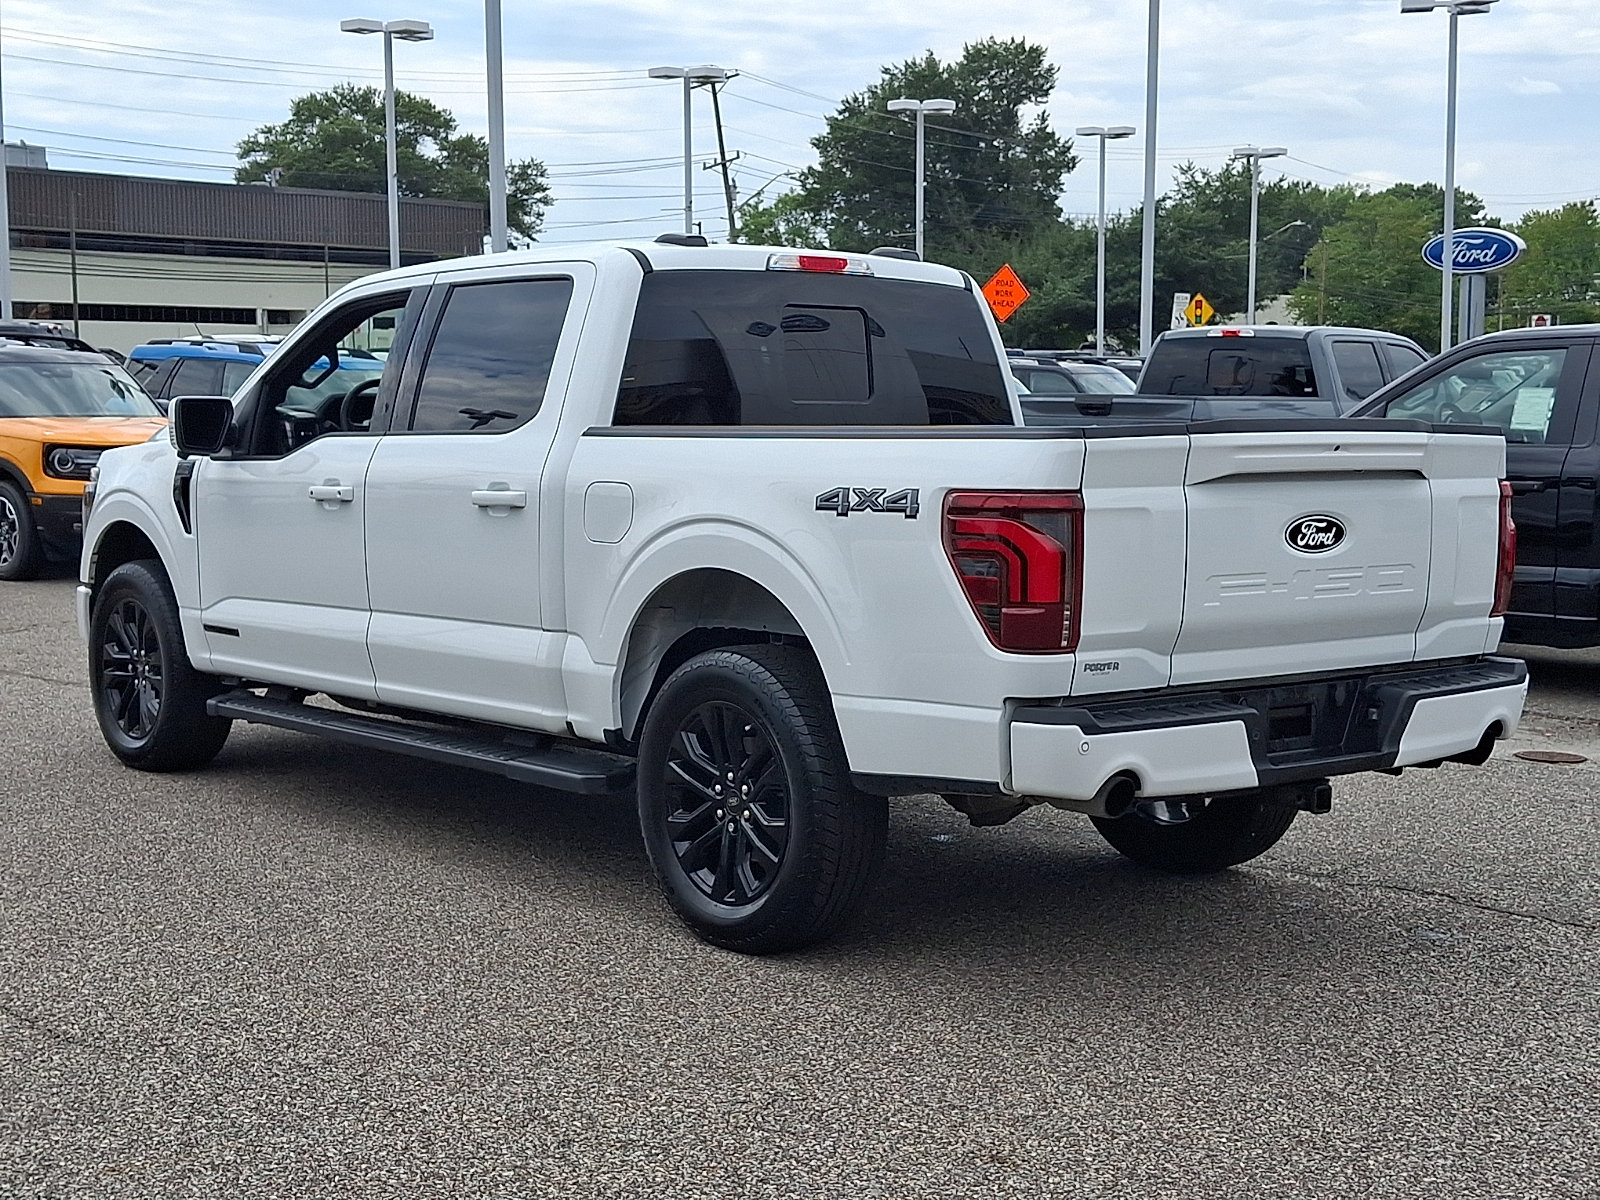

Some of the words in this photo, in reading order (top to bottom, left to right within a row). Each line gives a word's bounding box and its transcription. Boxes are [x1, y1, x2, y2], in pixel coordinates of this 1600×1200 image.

[1442, 237, 1498, 264] Ford
[995, 280, 1015, 288] ROAD
[992, 299, 1015, 308] AHEAD
[1297, 521, 1337, 546] Ford
[1203, 562, 1416, 606] F-150
[1083, 661, 1120, 673] PORTER
